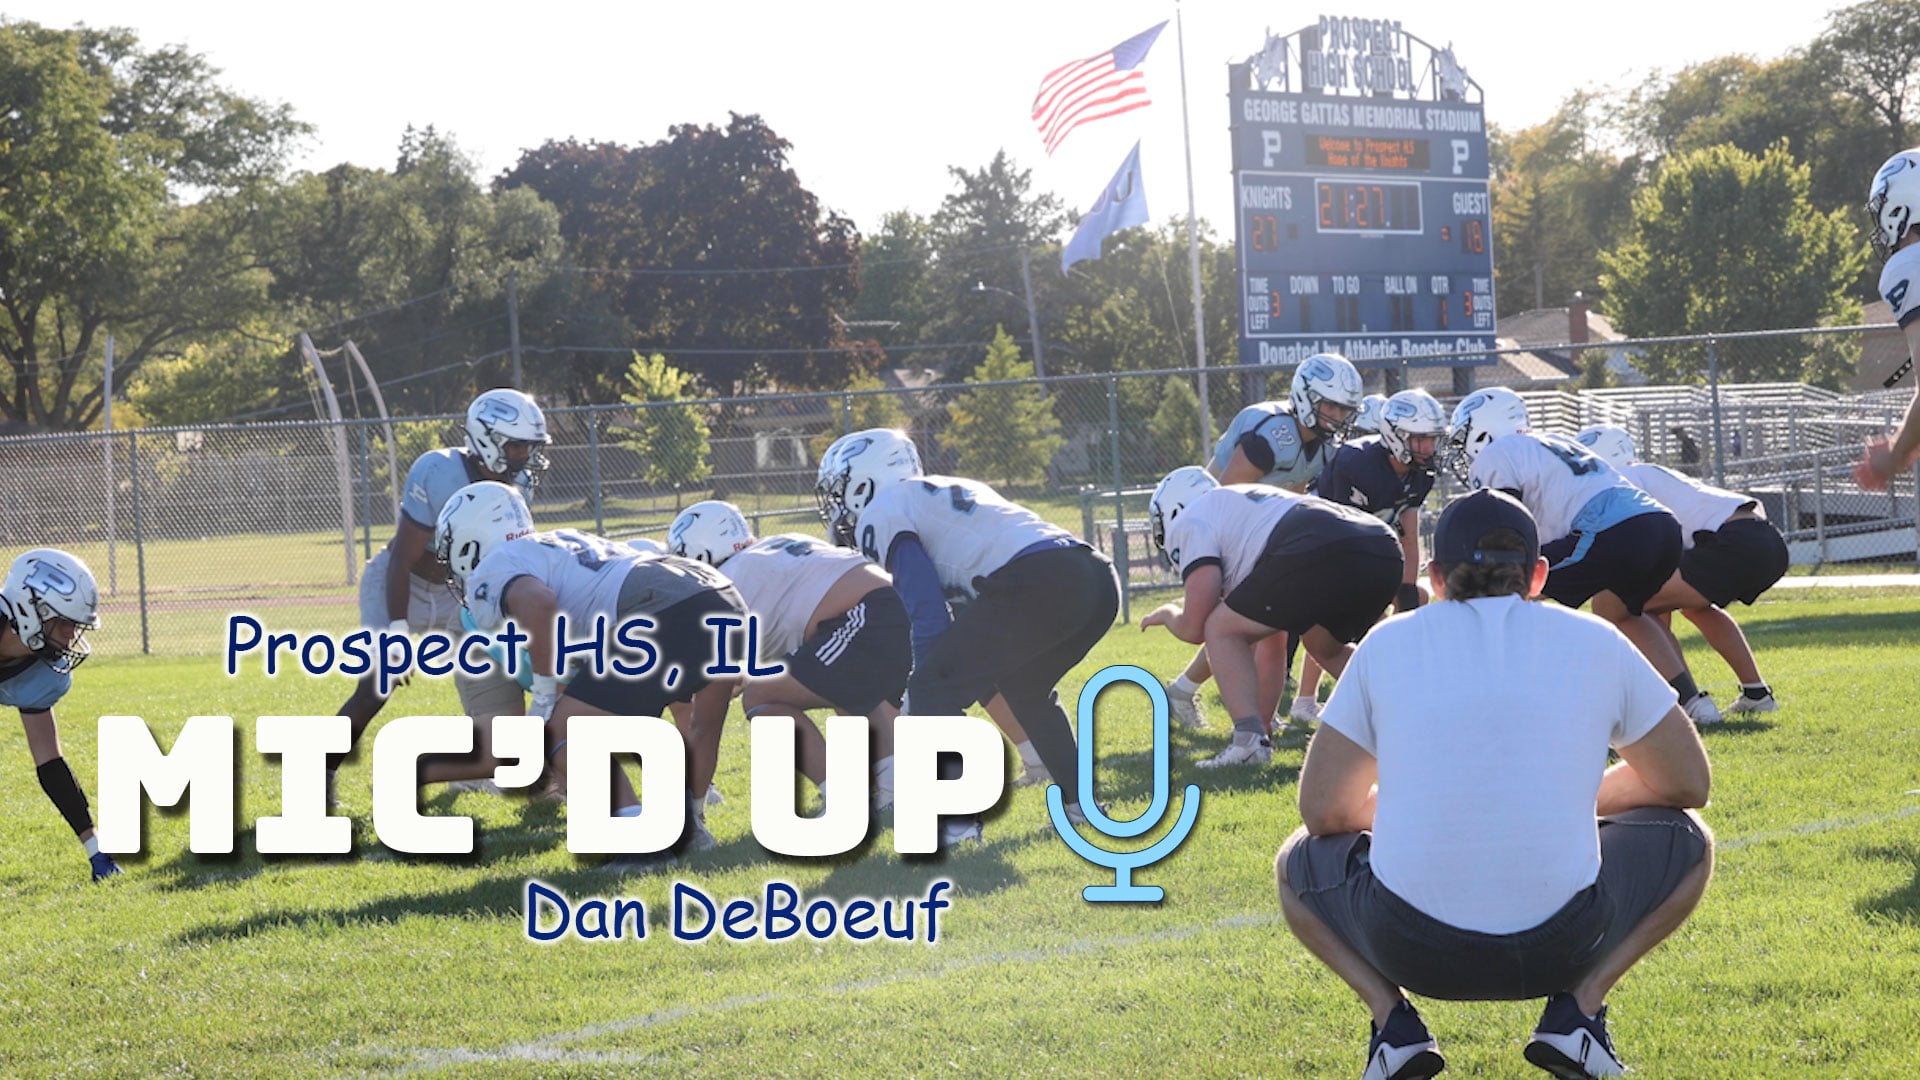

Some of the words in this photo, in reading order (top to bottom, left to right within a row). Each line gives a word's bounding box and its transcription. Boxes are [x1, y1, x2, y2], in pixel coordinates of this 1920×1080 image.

[1318, 14, 1402, 54] PROSPECT
[1307, 50, 1349, 90] HIGH
[1353, 54, 1417, 93] SCHOOL
[1243, 98, 1298, 123] GEORGE
[1300, 102, 1350, 127] GATTAS
[1353, 105, 1423, 129] MEMORIAL
[1425, 109, 1481, 132] STADIUM
[1261, 130, 1282, 168] P
[1450, 139, 1470, 175] P
[1241, 185, 1293, 210] KNIGHTS
[1453, 192, 1487, 215] GUEST
[1252, 215, 1278, 251] 27
[1249, 277, 1269, 294] TIME
[1290, 275, 1319, 295] DOWN
[1332, 276, 1345, 295] TO
[1346, 276, 1360, 295] GO
[1384, 275, 1405, 295] BALL
[1405, 275, 1418, 295] ON
[1431, 276, 1449, 295] QTR
[1472, 278, 1490, 294] TIME
[1248, 295, 1269, 312] OUTS
[1271, 291, 1280, 318] 3
[1464, 291, 1473, 318] 3
[1473, 295, 1493, 312] OUTS
[1250, 313, 1269, 330] LEFT
[1474, 312, 1491, 328] LEFT
[1259, 340, 1318, 365] Donated
[1344, 339, 1398, 362] Athletic
[1456, 337, 1487, 361] Club
[23, 560, 77, 596] P
